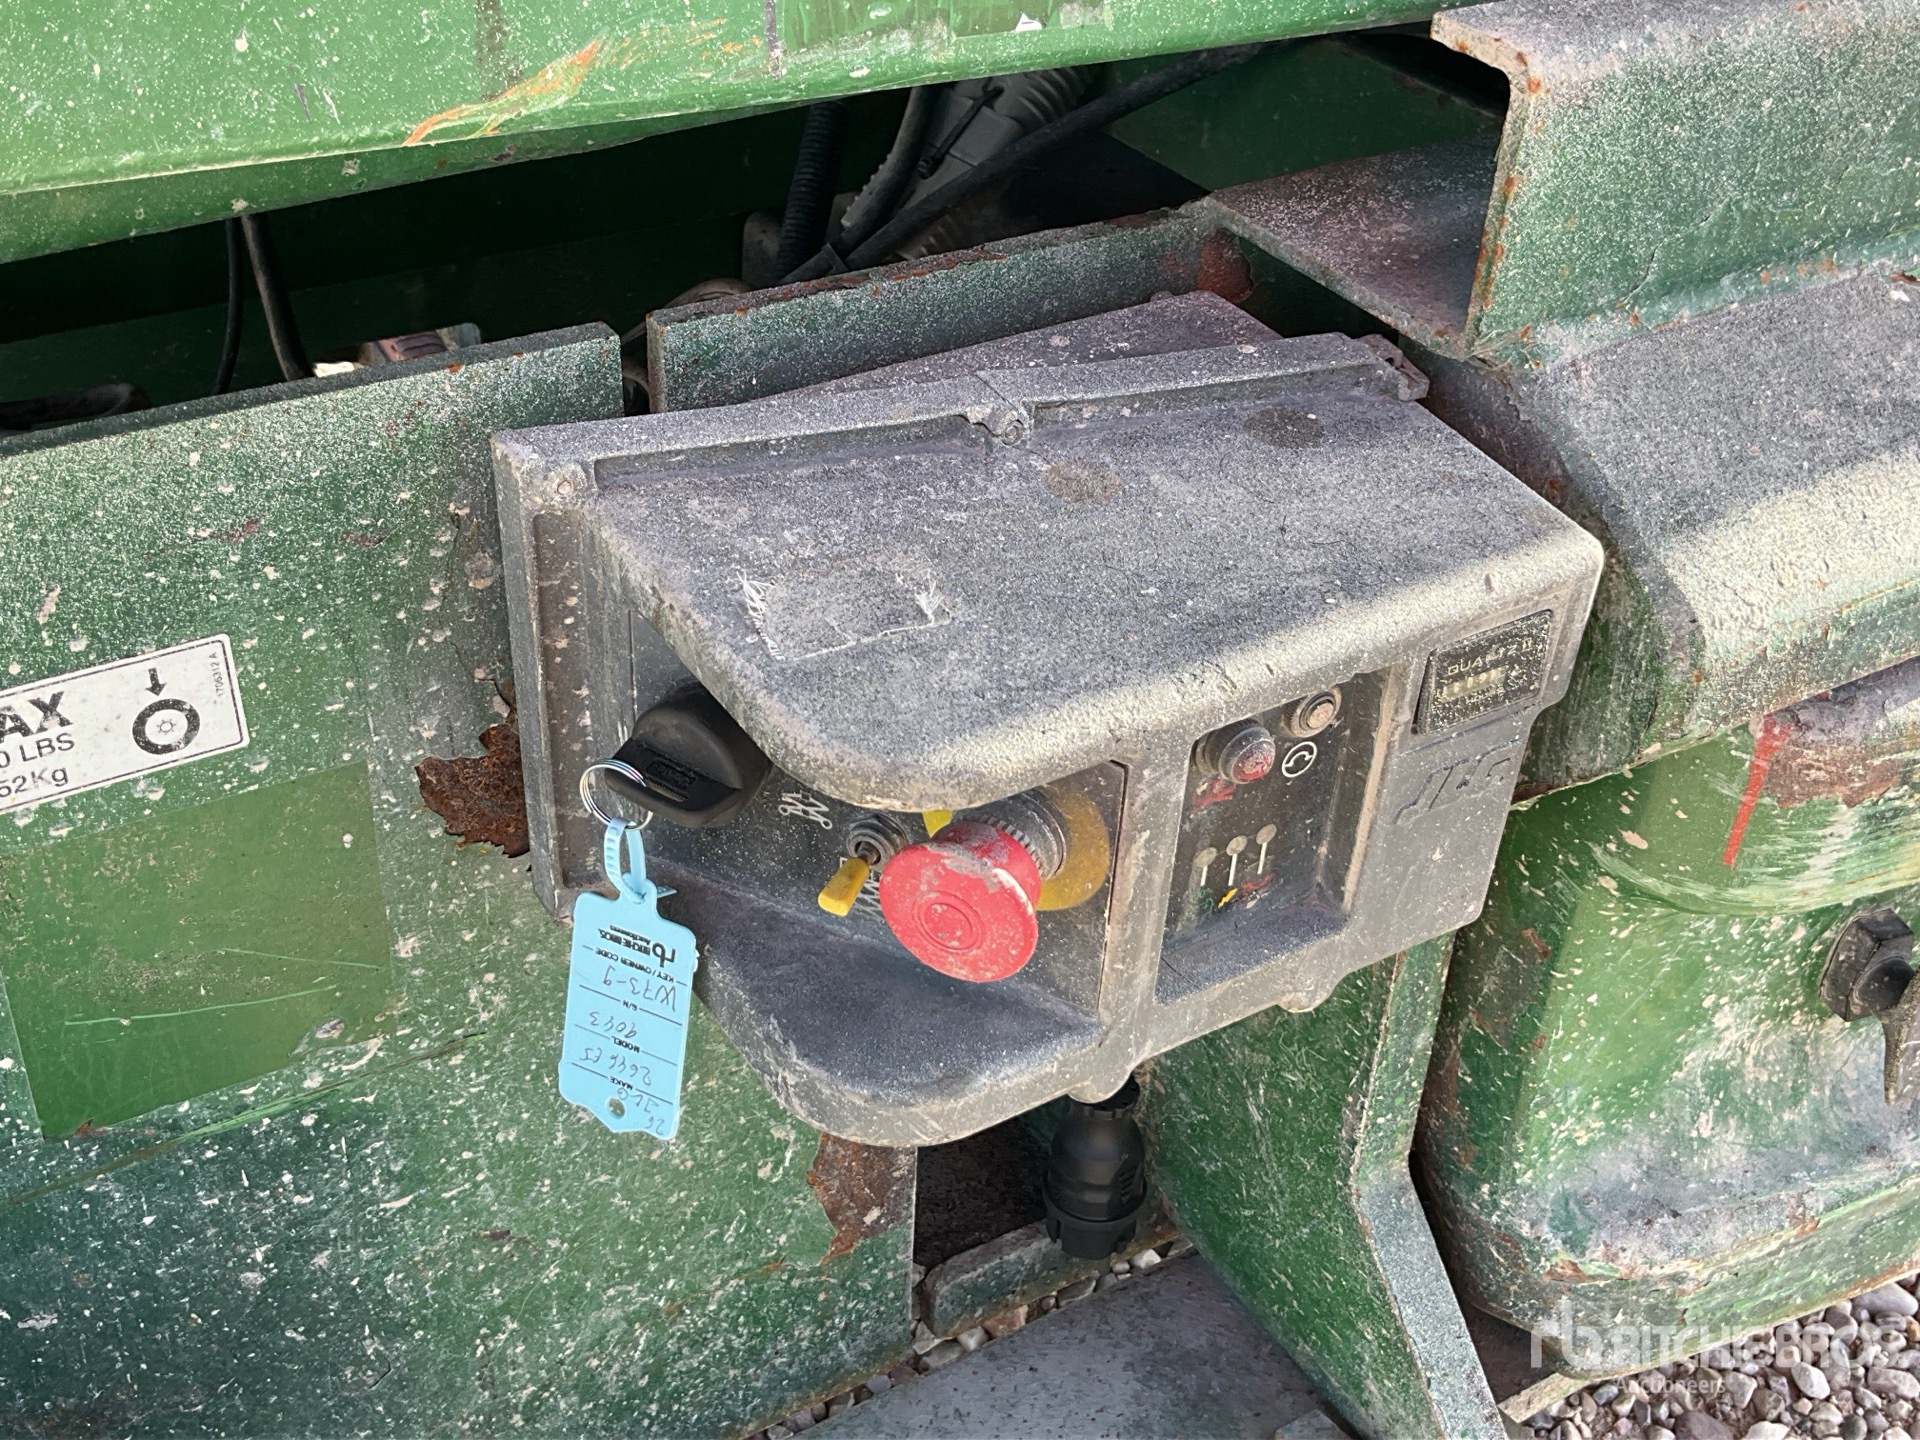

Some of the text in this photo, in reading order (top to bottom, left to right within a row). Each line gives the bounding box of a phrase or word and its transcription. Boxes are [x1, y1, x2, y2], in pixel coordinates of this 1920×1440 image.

[19, 732, 75, 762] LBS
[596, 947, 619, 962] CODE
[611, 1036, 640, 1053] MODEL
[610, 1076, 633, 1090] MAKE
